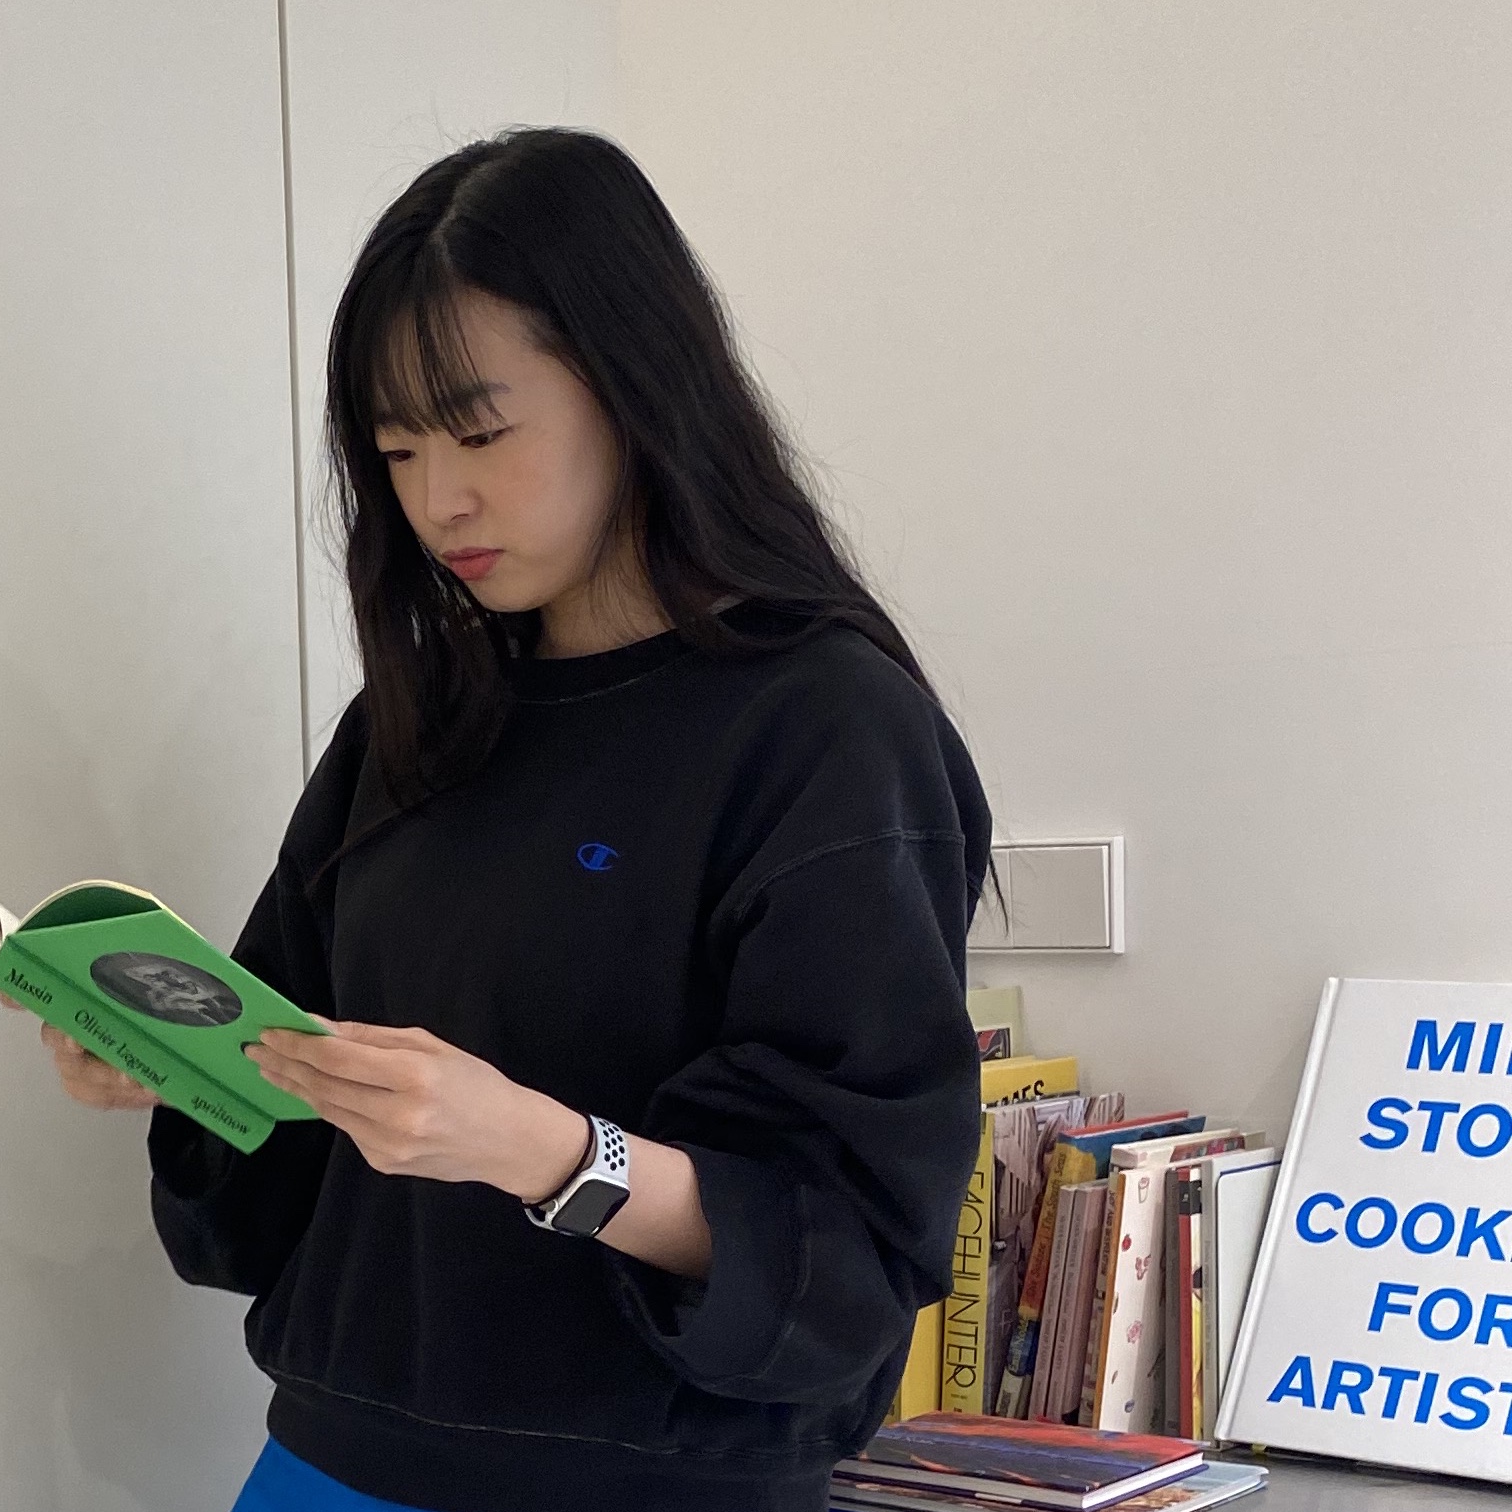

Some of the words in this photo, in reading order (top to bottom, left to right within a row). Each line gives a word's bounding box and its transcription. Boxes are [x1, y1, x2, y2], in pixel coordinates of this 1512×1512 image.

[4, 968, 52, 1004] Massin
[1406, 1019, 1512, 1075] MI
[1359, 1097, 1512, 1158] STO
[1040, 1209, 1054, 1231] The
[1053, 1152, 1068, 1176] Seas
[1295, 1192, 1512, 1262] COOK
[1367, 1281, 1512, 1347] FOR
